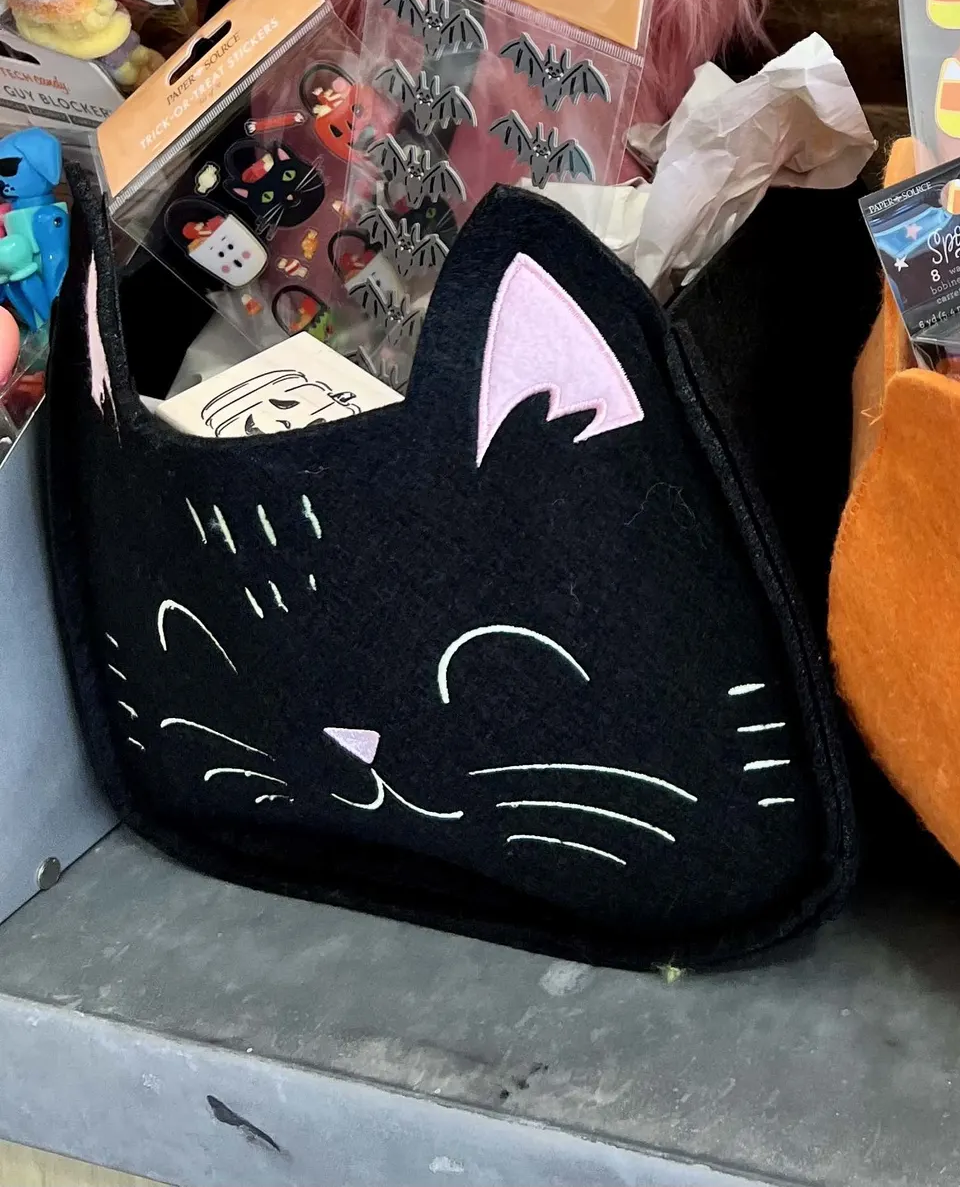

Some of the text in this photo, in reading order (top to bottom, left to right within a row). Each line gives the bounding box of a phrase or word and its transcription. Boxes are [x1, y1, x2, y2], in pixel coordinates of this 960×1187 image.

[139, 17, 280, 151] TRICK-OR-TREAT STICKERS
[167, 74, 196, 107] PAPER
[204, 33, 241, 71] SOURCE
[4, 85, 35, 102] GUY
[868, 181, 933, 214] PAPER SOURCE
[930, 269, 941, 282] 8
